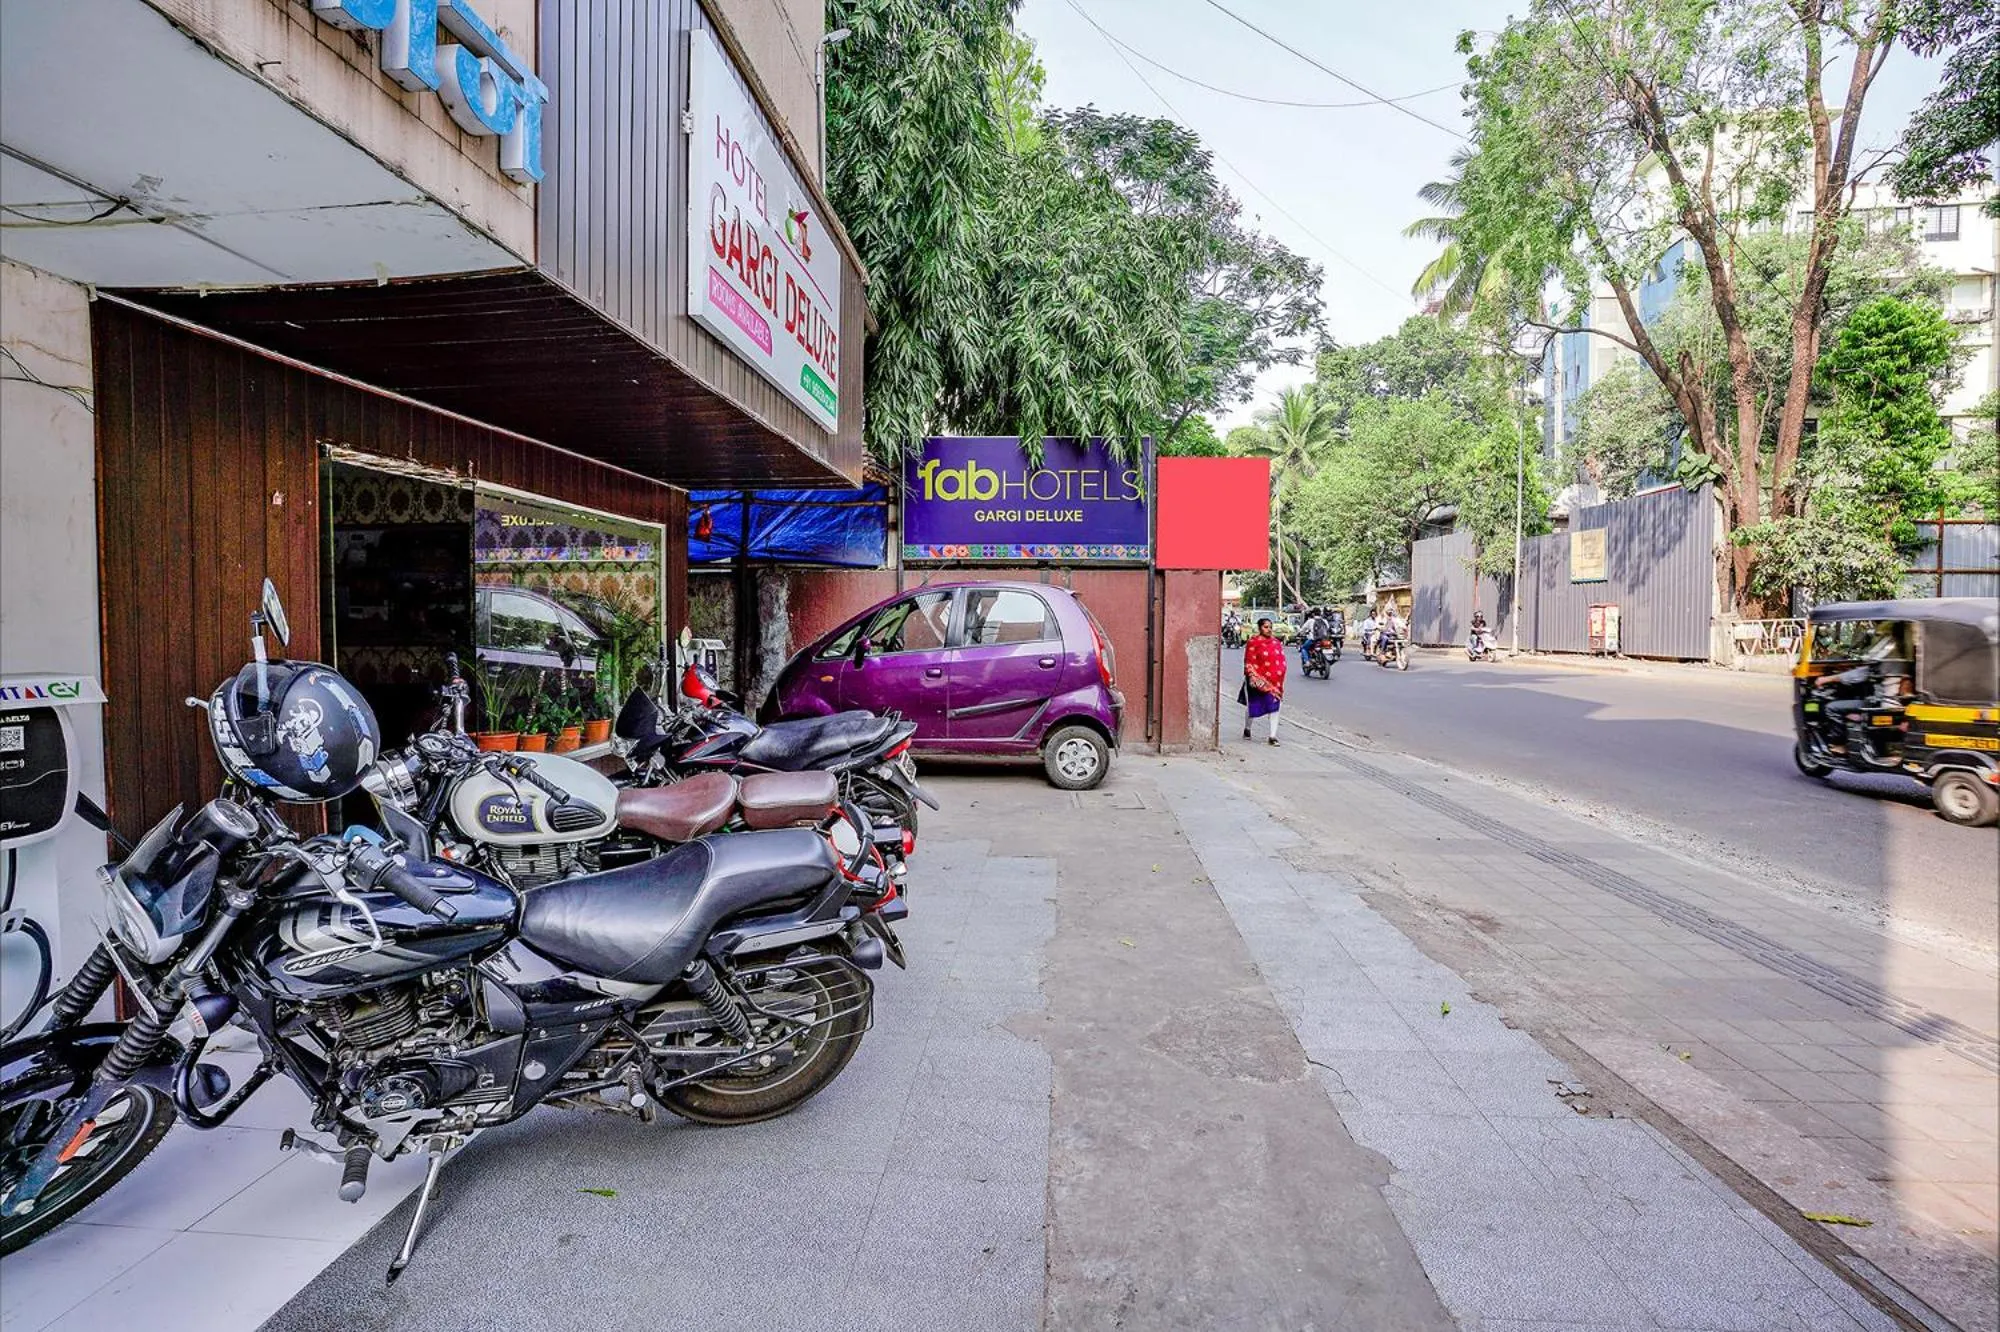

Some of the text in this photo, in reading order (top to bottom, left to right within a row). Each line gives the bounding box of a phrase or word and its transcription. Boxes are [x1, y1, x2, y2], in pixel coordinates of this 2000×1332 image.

[715, 114, 770, 226] HOTEL
[710, 181, 779, 319] GARGI
[784, 271, 837, 382] DELUXE
[974, 510, 1083, 522] GARGI DELUXE
[490, 804, 522, 815] ROYAL
[487, 814, 527, 824] ENFIELD
